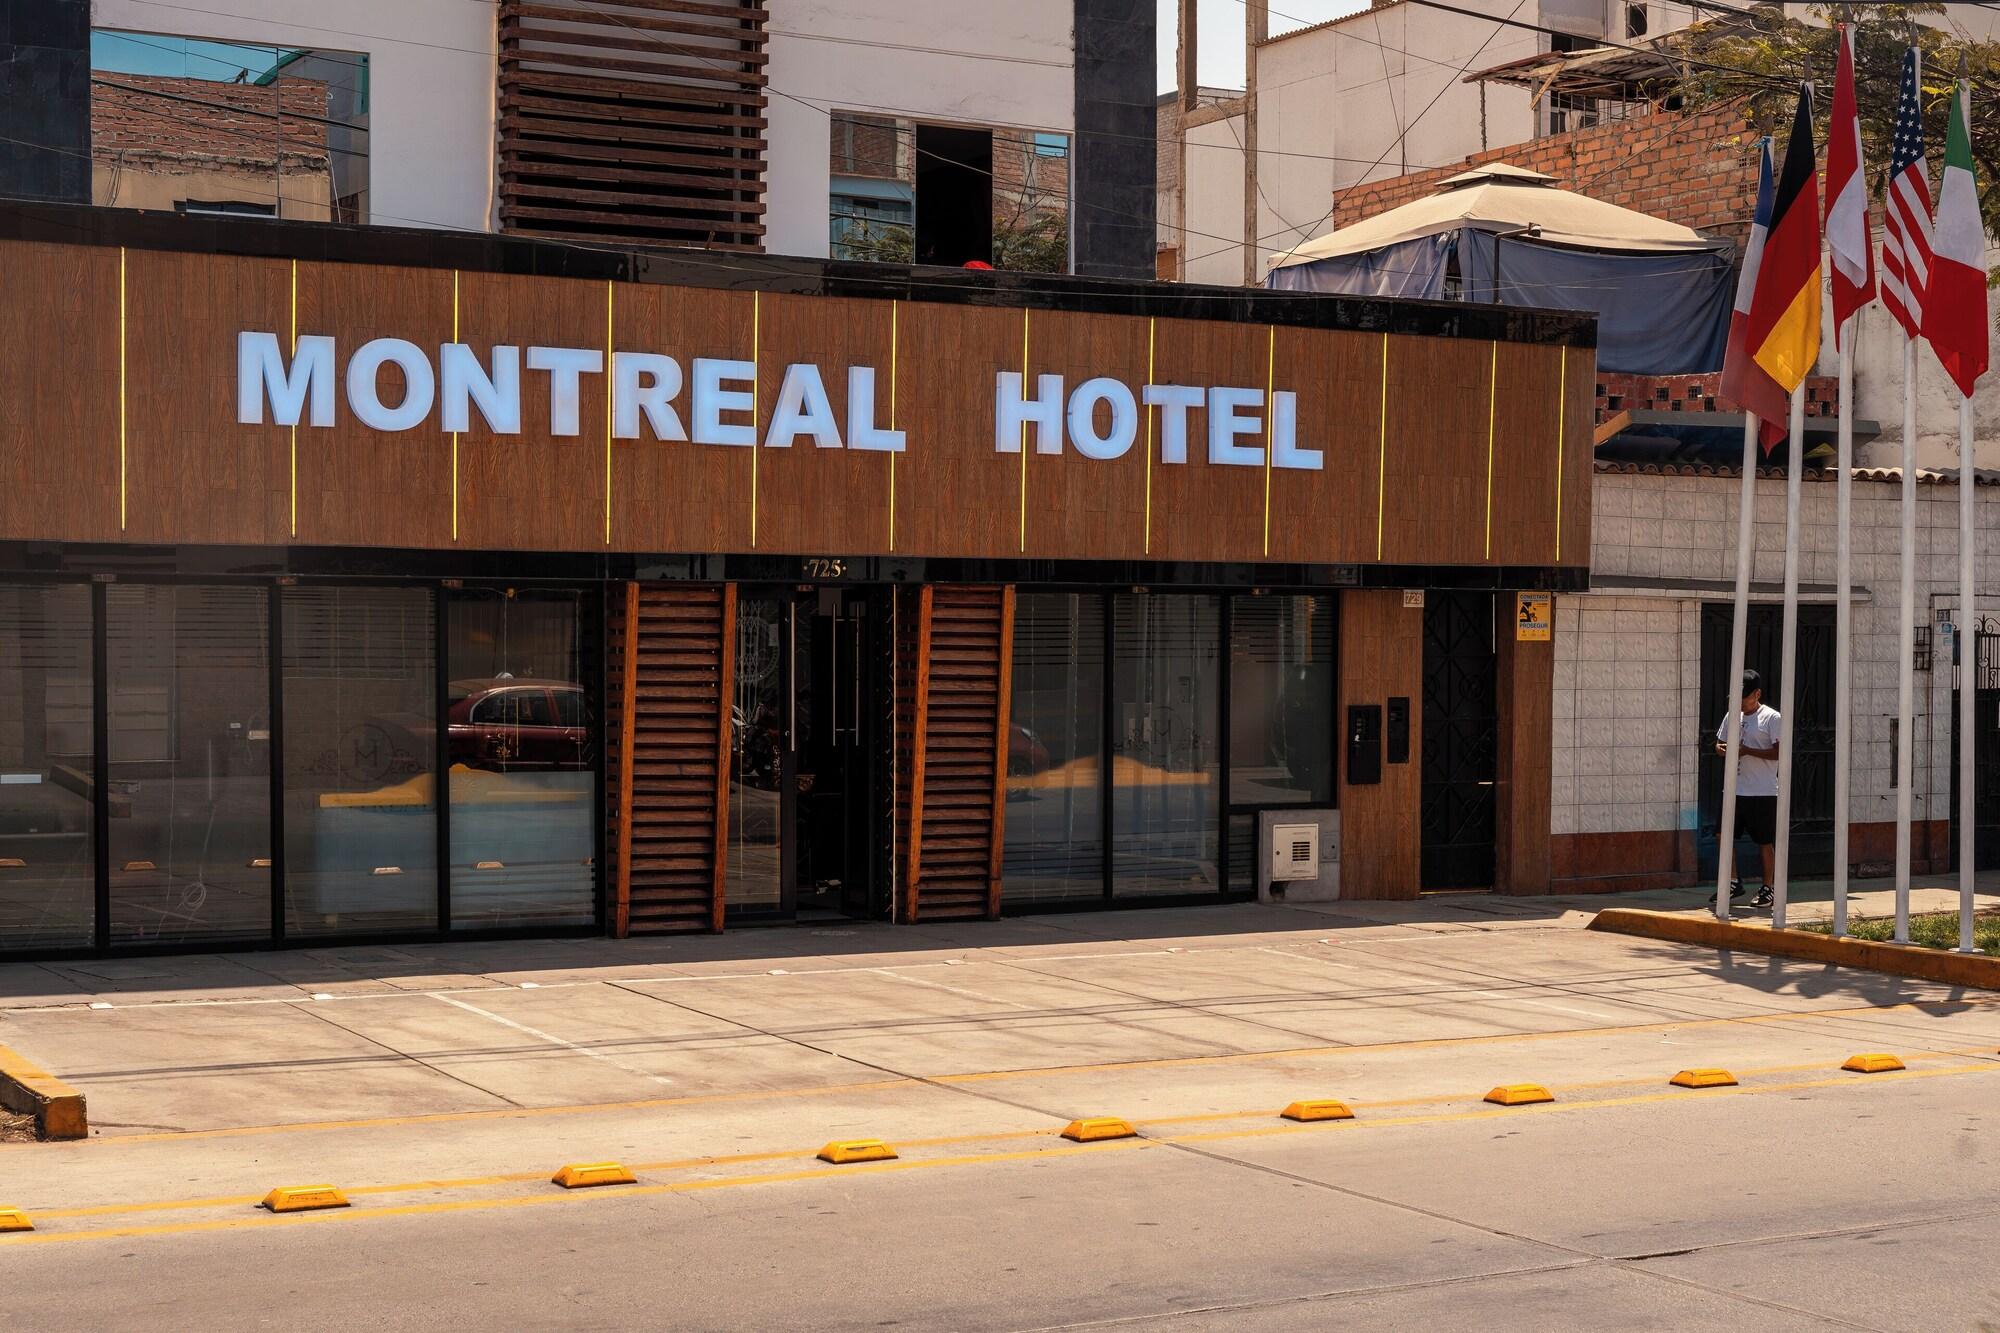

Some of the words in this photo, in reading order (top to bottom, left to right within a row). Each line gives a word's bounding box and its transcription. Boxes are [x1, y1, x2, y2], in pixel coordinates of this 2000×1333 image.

[238, 331, 907, 452] MONTREAL
[995, 371, 1323, 470] HOTEL
[808, 559, 842, 577] 725
[1406, 593, 1422, 604] 729
